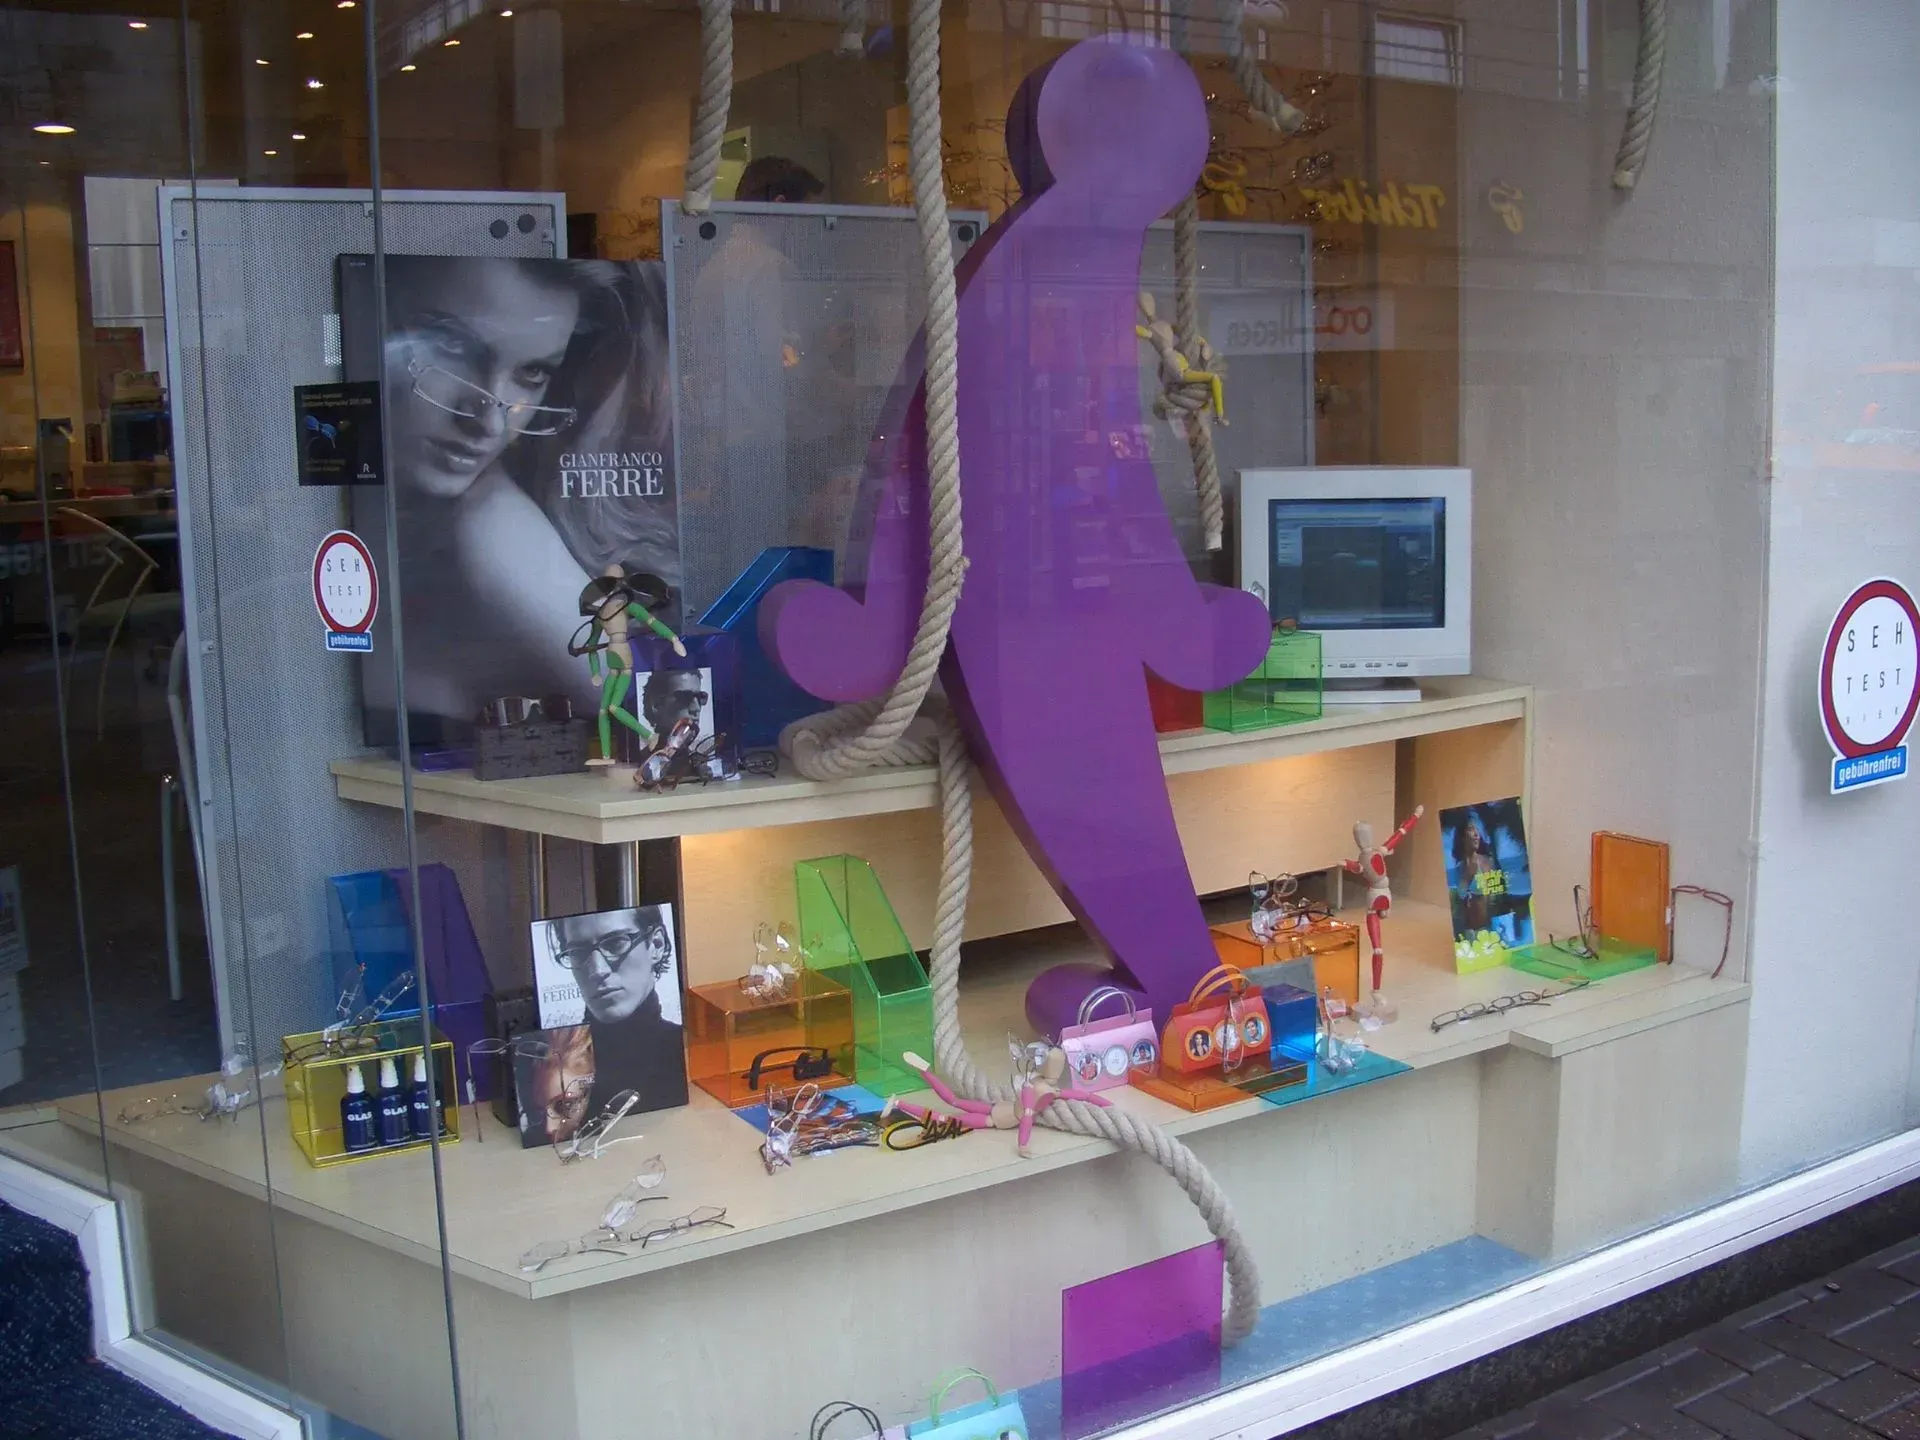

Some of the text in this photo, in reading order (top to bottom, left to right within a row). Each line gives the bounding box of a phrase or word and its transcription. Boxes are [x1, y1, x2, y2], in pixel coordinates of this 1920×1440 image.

[560, 451, 663, 469] GIANFRANCO
[560, 467, 664, 498] FERRE
[326, 558, 361, 573] SEH
[328, 585, 362, 597] TEST
[1847, 621, 1903, 652] SEH
[1846, 668, 1901, 694] TEST
[1838, 753, 1902, 785] gebührenfrei
[413, 1099, 441, 1110] GLS
